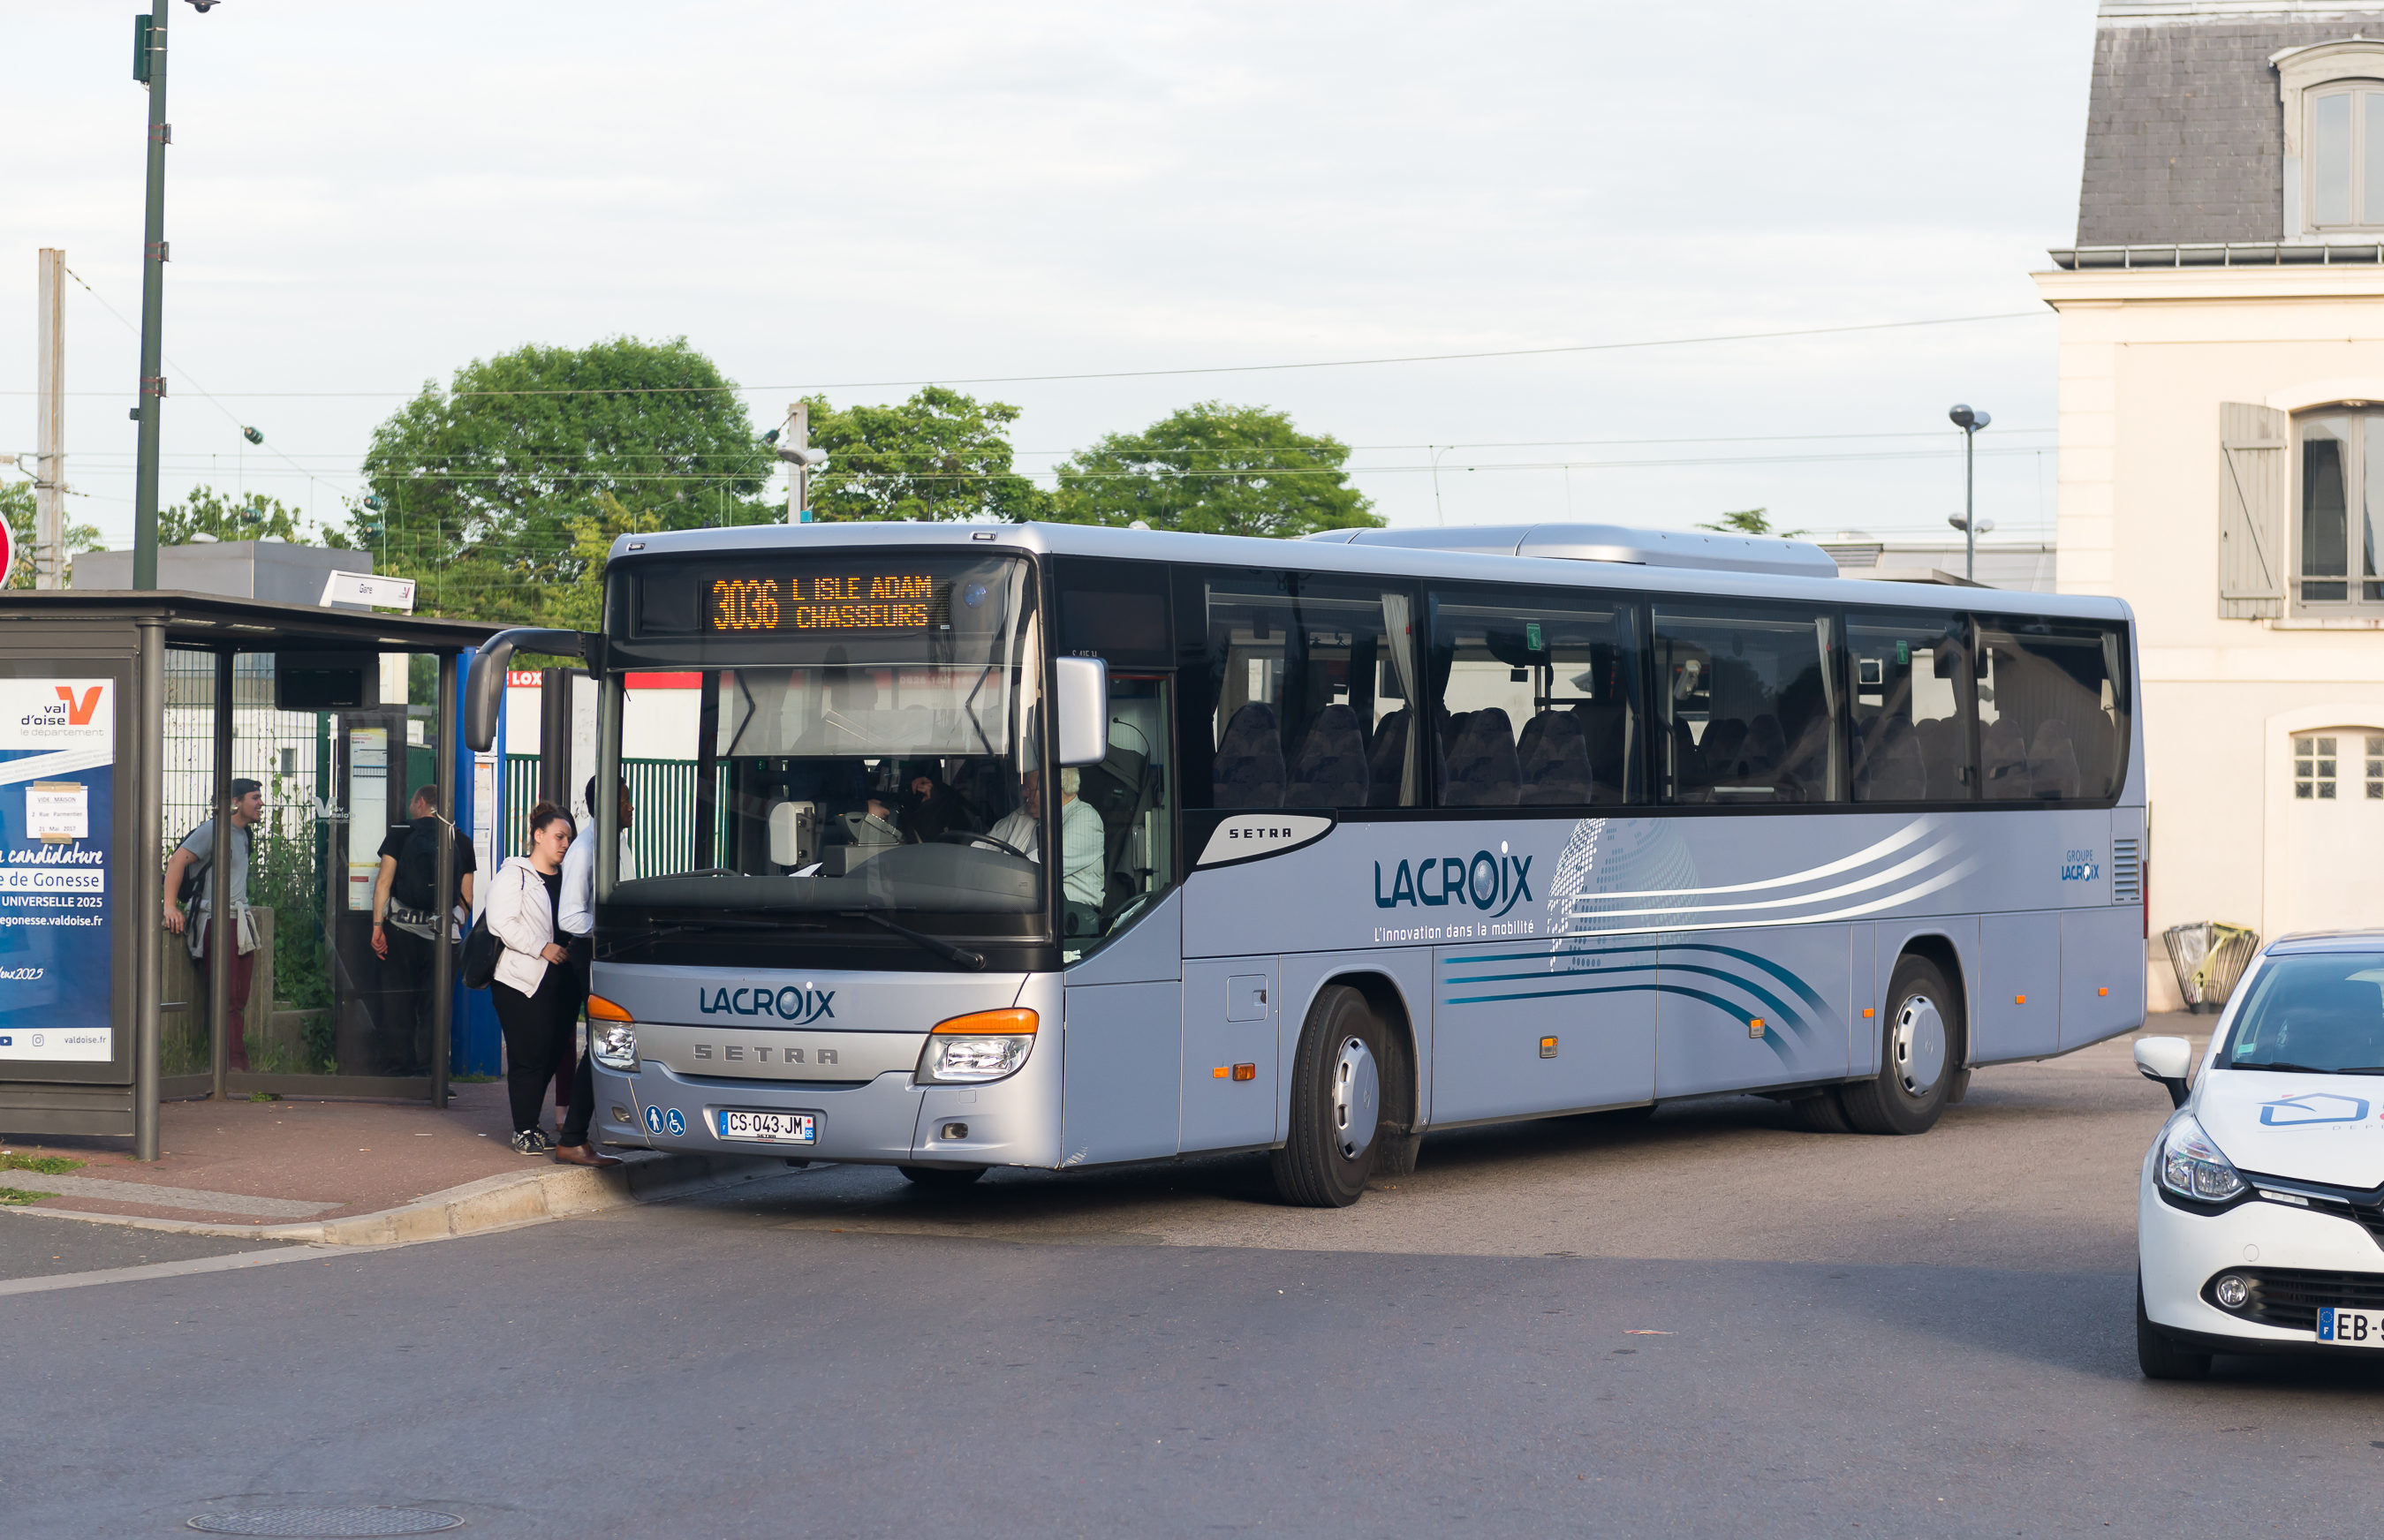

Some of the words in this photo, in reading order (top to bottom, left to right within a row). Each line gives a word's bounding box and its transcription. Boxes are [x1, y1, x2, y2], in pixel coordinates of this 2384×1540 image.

[359, 584, 373, 594] Gare
[792, 578, 806, 600] L
[814, 578, 860, 600] ISLE
[870, 575, 931, 599] ADAM
[713, 579, 778, 629] 3036
[796, 603, 928, 628] CHASSEURS
[44, 703, 66, 713] val
[21, 714, 66, 726] d'oise
[32, 728, 104, 737] département
[1229, 827, 1292, 839] SETRA
[8, 842, 103, 864] candidature
[2066, 849, 2093, 862] GROUPE
[10, 871, 28, 887] de
[34, 872, 100, 887] Gonesse
[2, 895, 75, 908] UNIVERSELLE
[77, 896, 103, 908] 2025
[1374, 925, 1442, 942] L'innovation
[1446, 924, 1472, 939] dans
[1477, 922, 1487, 936] la
[1492, 919, 1534, 936] mobilité
[693, 1044, 838, 1065] SETRA
[2324, 1326, 2329, 1335] F
[2337, 1314, 2384, 1340] EB-
